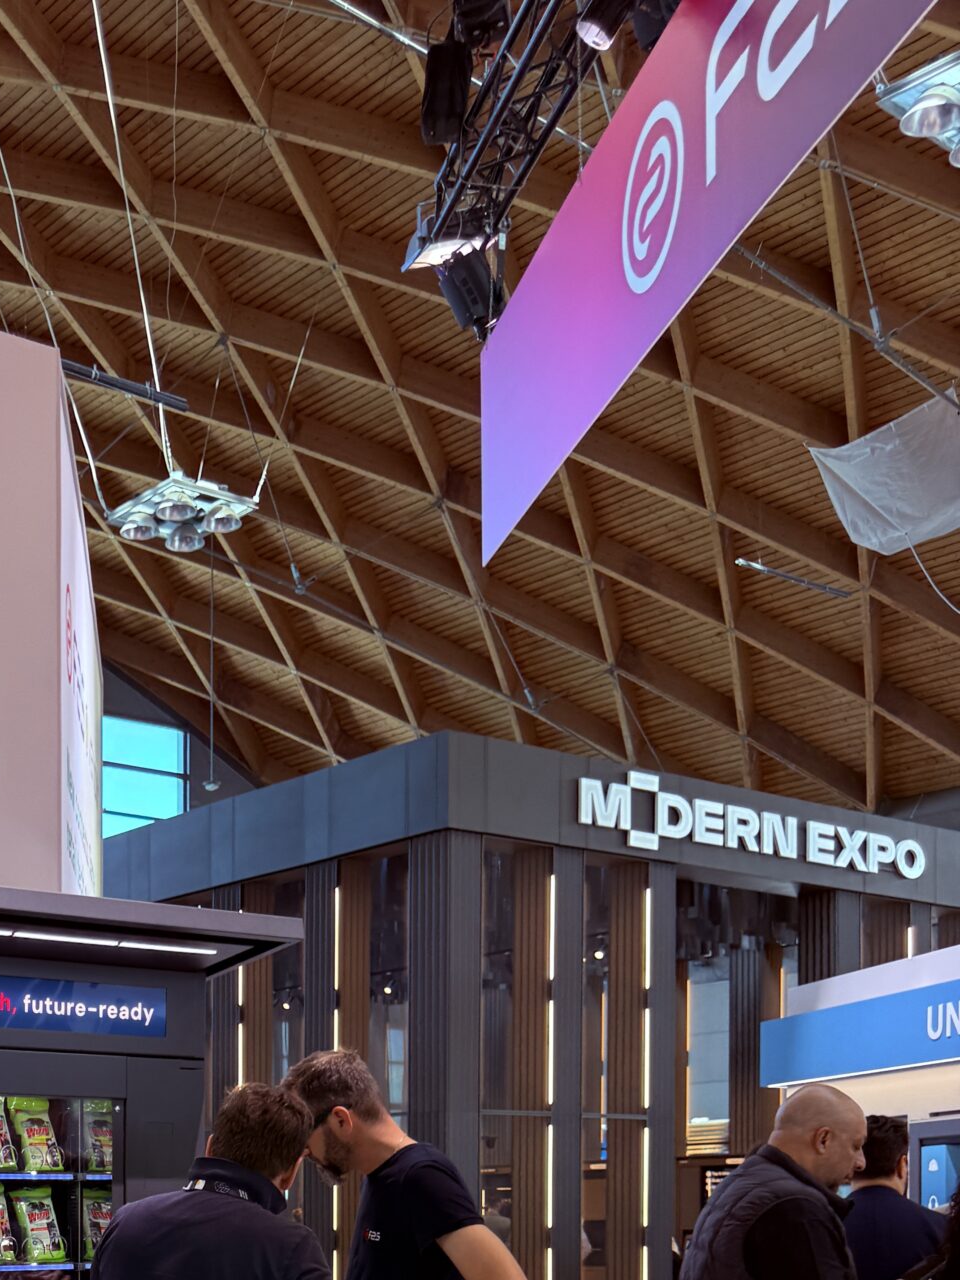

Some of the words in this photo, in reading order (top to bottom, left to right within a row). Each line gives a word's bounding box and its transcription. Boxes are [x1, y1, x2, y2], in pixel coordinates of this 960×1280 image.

[577, 770, 798, 859] MODERN
[805, 820, 926, 880] EXPO
[23, 993, 155, 1027] future-ready
